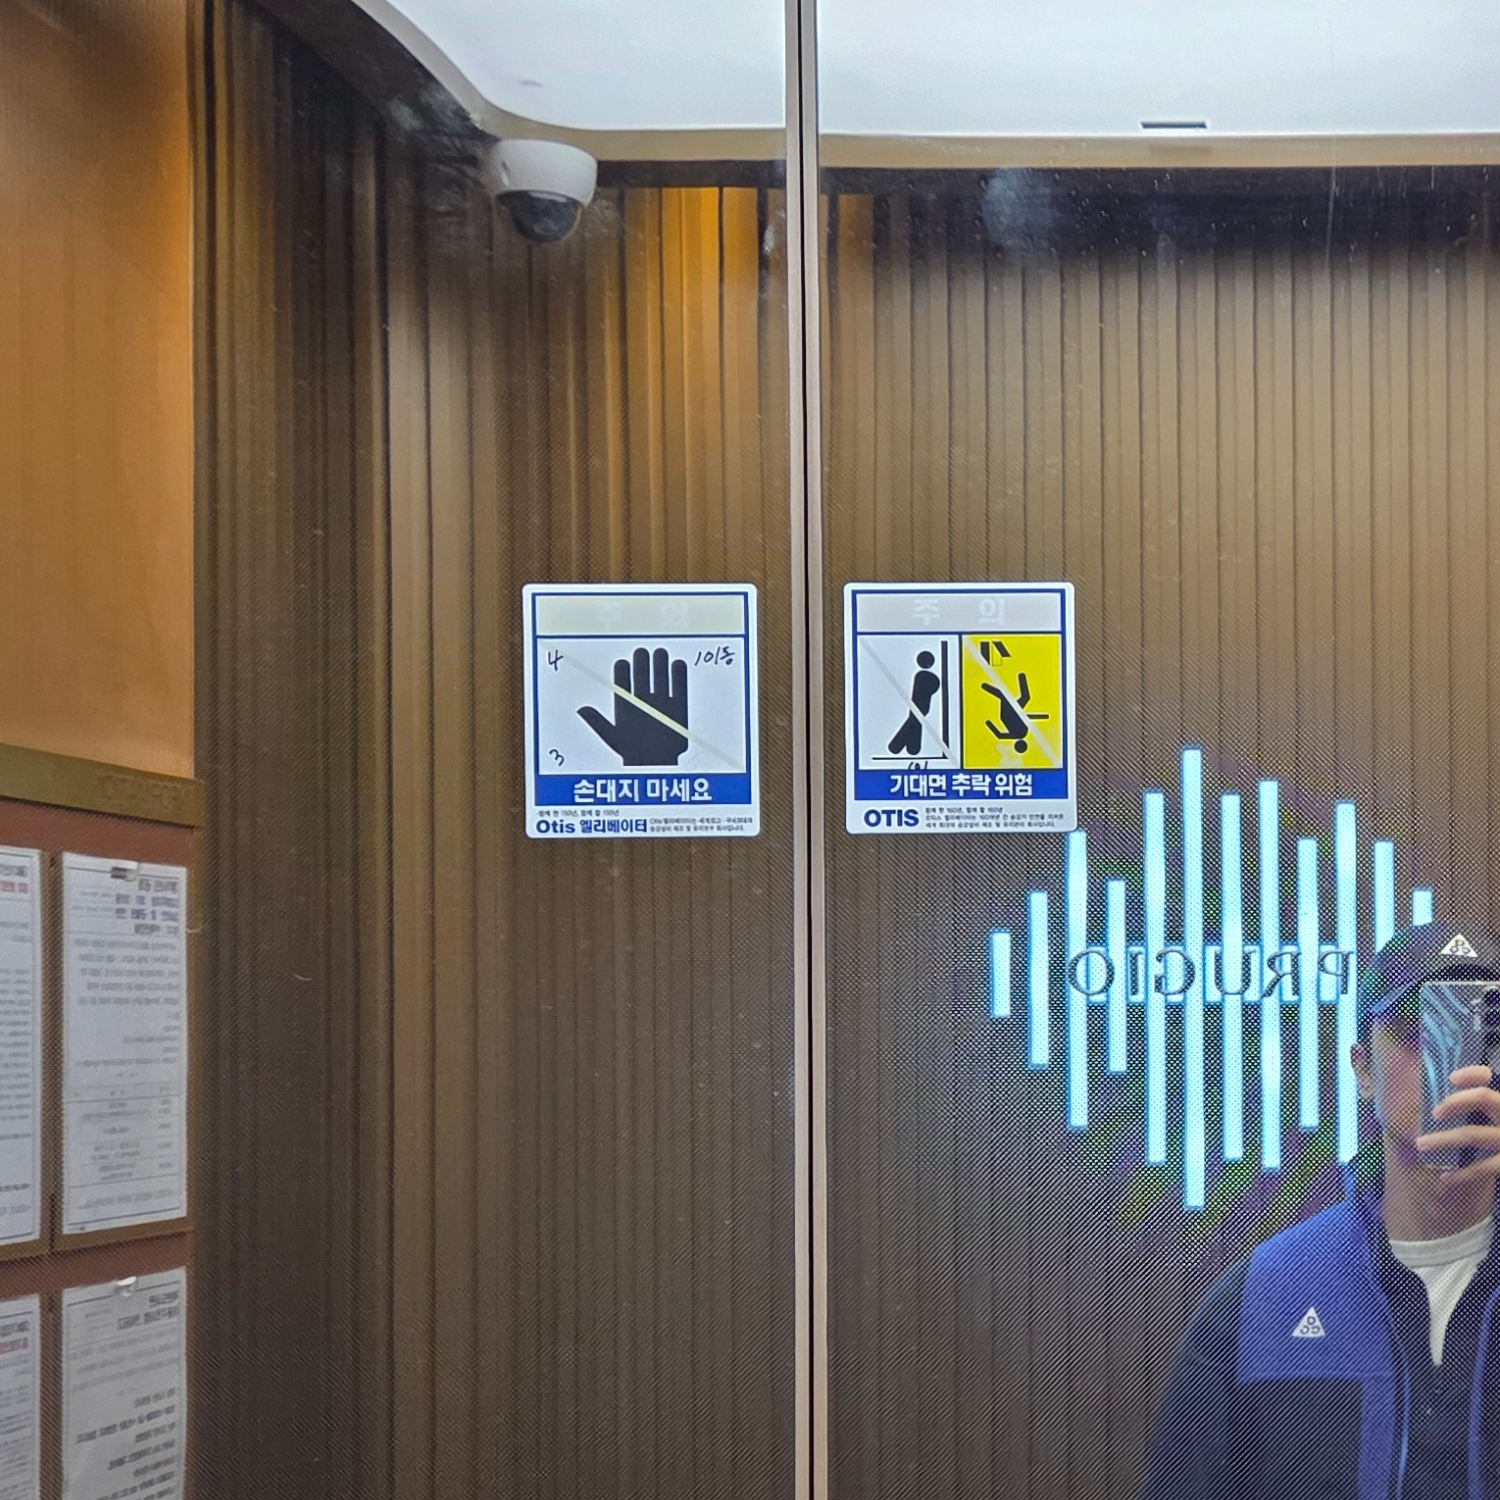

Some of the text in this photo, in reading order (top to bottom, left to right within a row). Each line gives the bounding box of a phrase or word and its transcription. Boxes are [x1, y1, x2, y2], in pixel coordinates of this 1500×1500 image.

[547, 650, 564, 672] 4
[549, 749, 565, 766] 3
[573, 778, 713, 803] 손대지 마세요
[890, 773, 1033, 797] 기대면 추락 위험
[536, 820, 576, 833] Otis
[580, 819, 647, 833] 엘리베이터
[864, 809, 920, 827] OTIS
